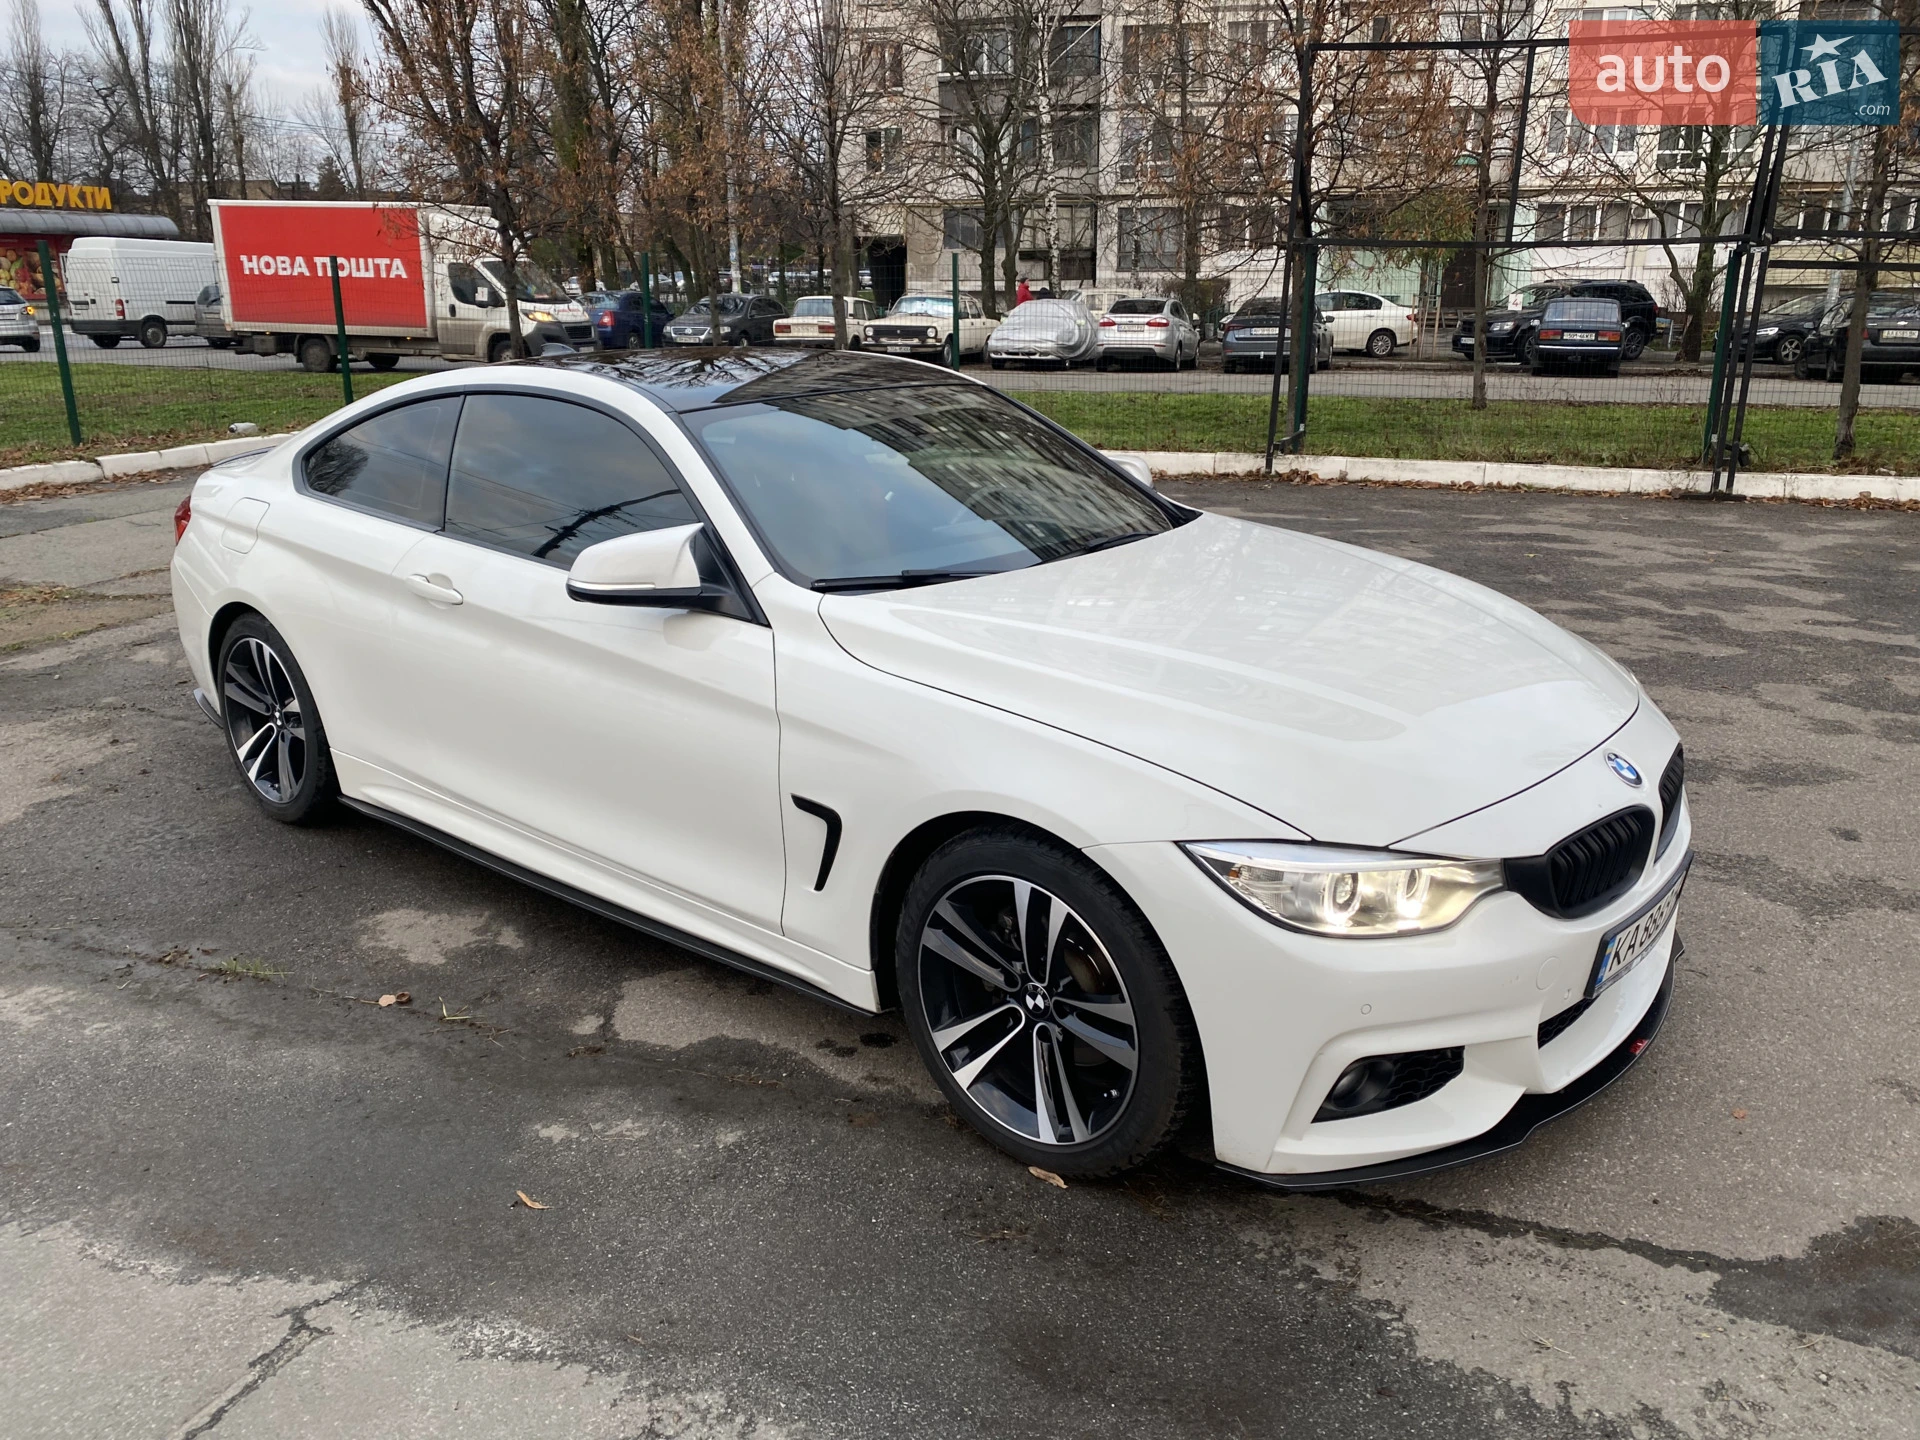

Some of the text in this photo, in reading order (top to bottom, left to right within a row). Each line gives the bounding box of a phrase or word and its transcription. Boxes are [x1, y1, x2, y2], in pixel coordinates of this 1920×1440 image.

[240, 254, 408, 279] НОВА ПОШТА
[1512, 298, 1519, 307] 4
